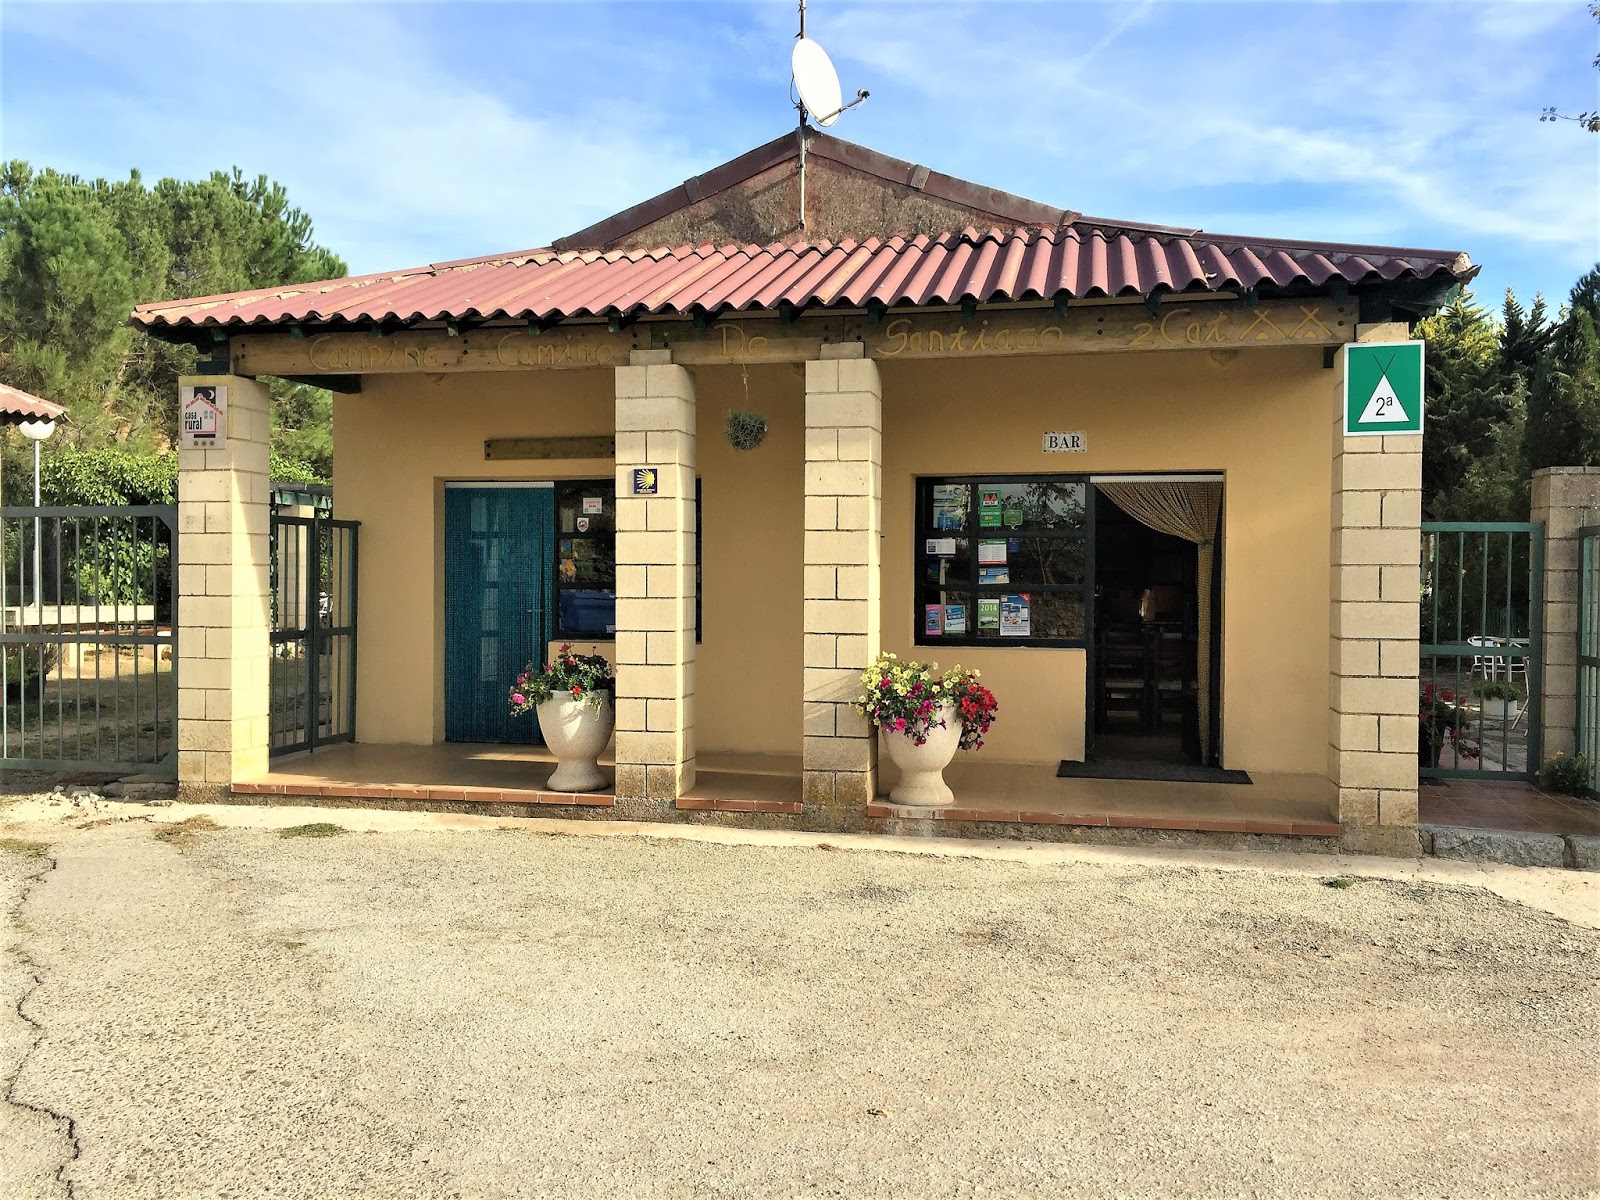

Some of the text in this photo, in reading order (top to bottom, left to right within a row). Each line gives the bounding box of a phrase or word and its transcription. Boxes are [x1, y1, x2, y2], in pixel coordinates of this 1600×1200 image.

[714, 323, 770, 359] De
[184, 411, 197, 420] casa
[184, 417, 202, 430] rural
[1048, 435, 1081, 449] BAR
[980, 604, 997, 612] 2014
